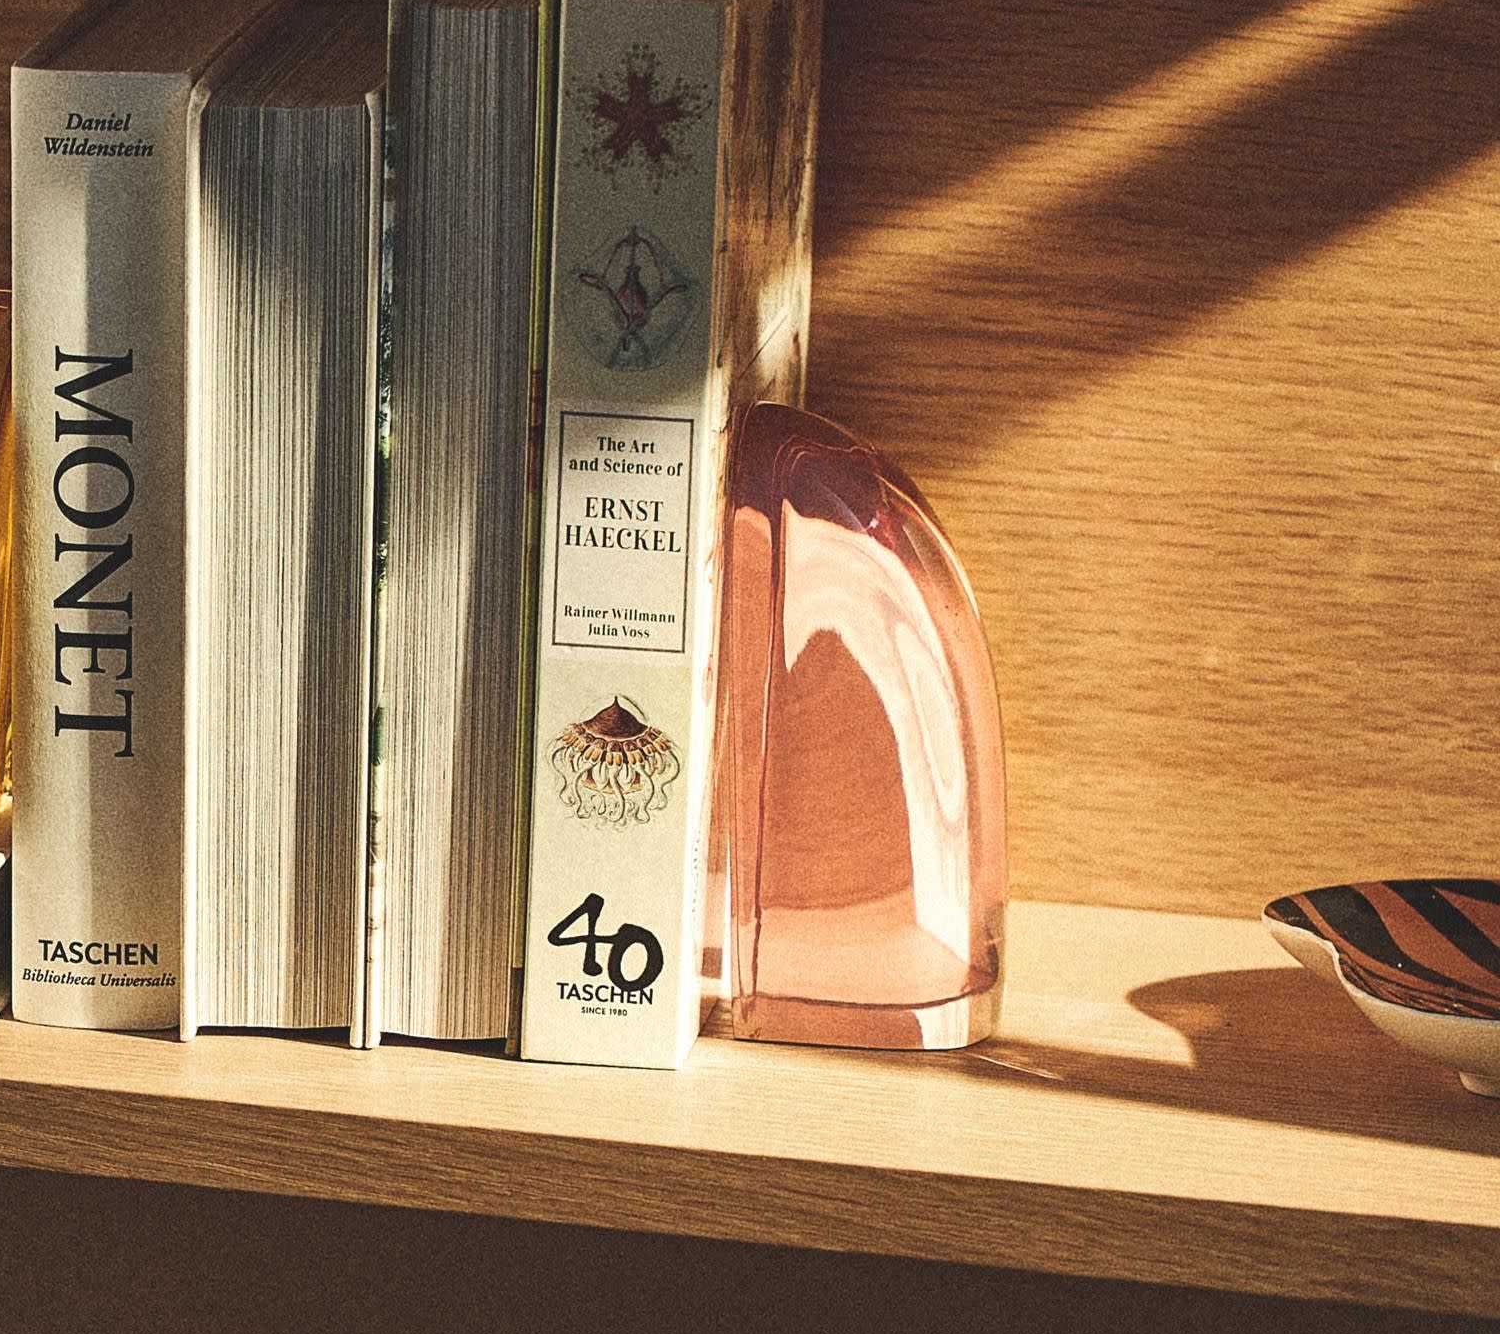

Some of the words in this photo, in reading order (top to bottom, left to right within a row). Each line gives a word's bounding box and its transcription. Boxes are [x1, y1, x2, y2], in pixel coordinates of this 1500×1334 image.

[65, 112, 132, 132] Daniel
[43, 136, 155, 157] Wildenstein
[597, 436, 626, 453] The
[629, 439, 656, 455] Art
[568, 456, 599, 472] and
[603, 458, 663, 476] Science
[666, 462, 684, 478] of
[584, 496, 665, 522] ERNST
[564, 524, 682, 554] HAECKEL
[53, 344, 136, 759] MONET
[564, 604, 609, 621] Rainer
[612, 607, 676, 624] Willmann
[587, 623, 619, 638] Julia
[622, 624, 650, 639] Voss
[38, 939, 159, 966] TASCHEN
[547, 893, 664, 993] 40
[22, 968, 97, 987] Bibliotheca
[100, 973, 178, 988] Universalis
[556, 982, 653, 1005] TASCHEN
[581, 1006, 606, 1016] SINCE
[609, 1008, 628, 1017] 1980
